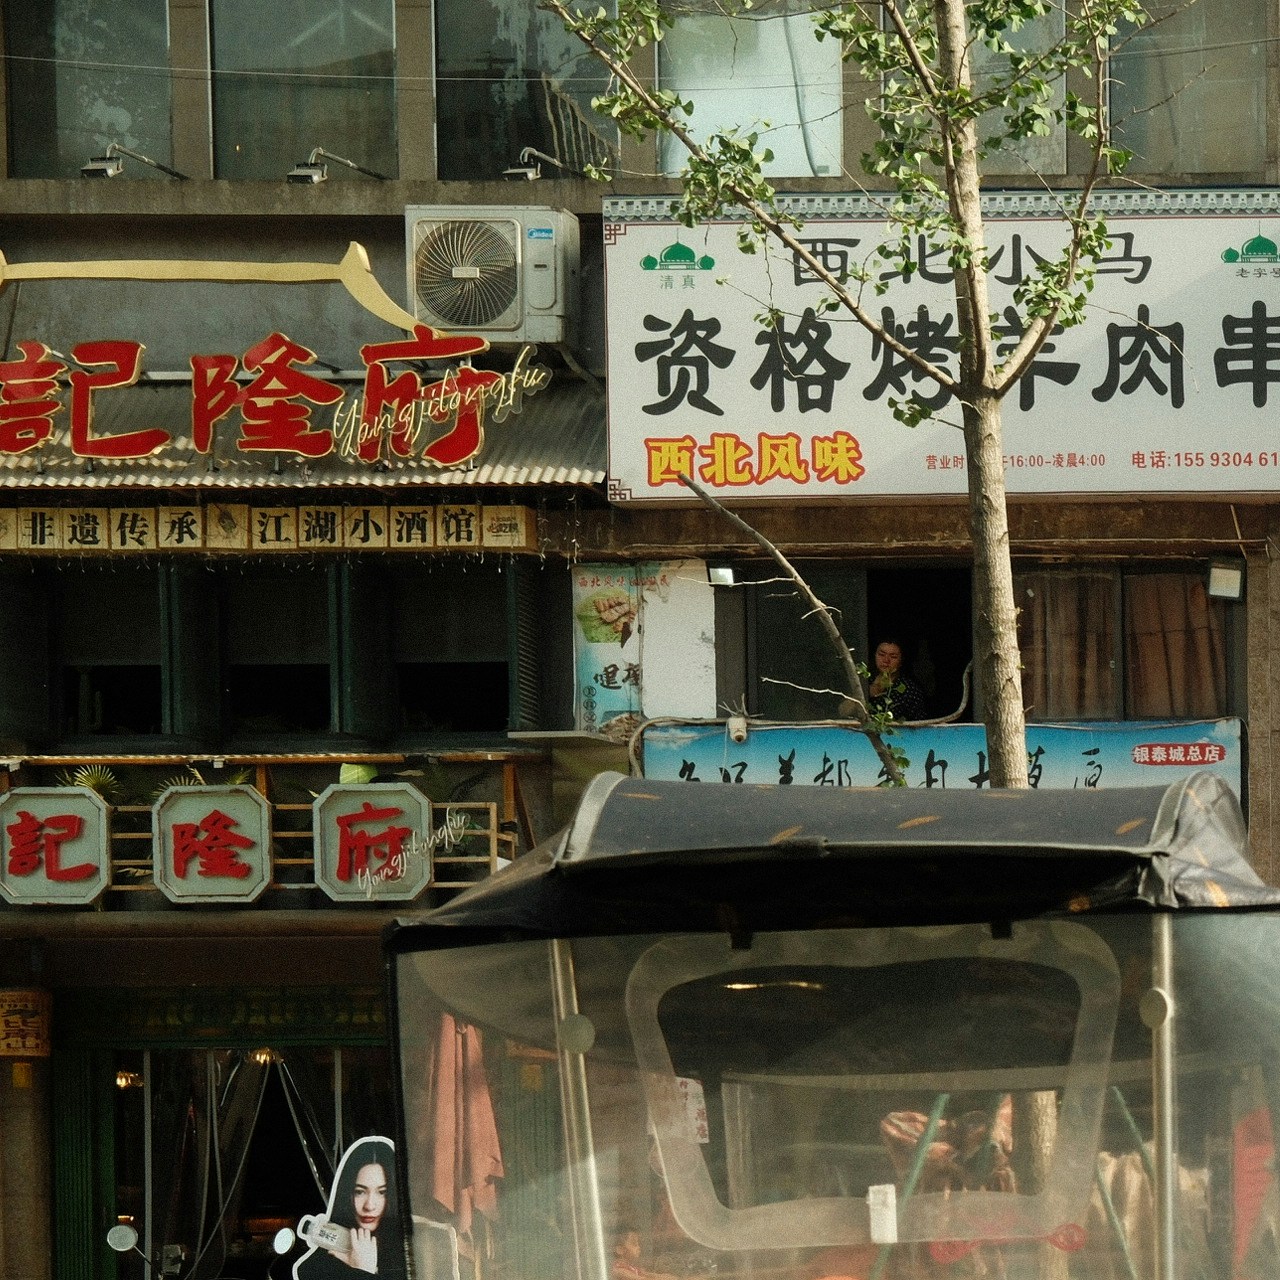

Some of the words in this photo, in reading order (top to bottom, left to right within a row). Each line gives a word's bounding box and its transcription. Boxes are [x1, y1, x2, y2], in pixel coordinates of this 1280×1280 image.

[659, 274, 696, 290] 清真
[645, 431, 867, 488] 西北风味
[1209, 451, 1253, 467] 9304
[24, 511, 199, 546] 非遗传承
[257, 508, 476, 546] 江湖小酒馆
[1133, 744, 1221, 764] 银泰城总店
[7, 802, 413, 884] 記隆府
